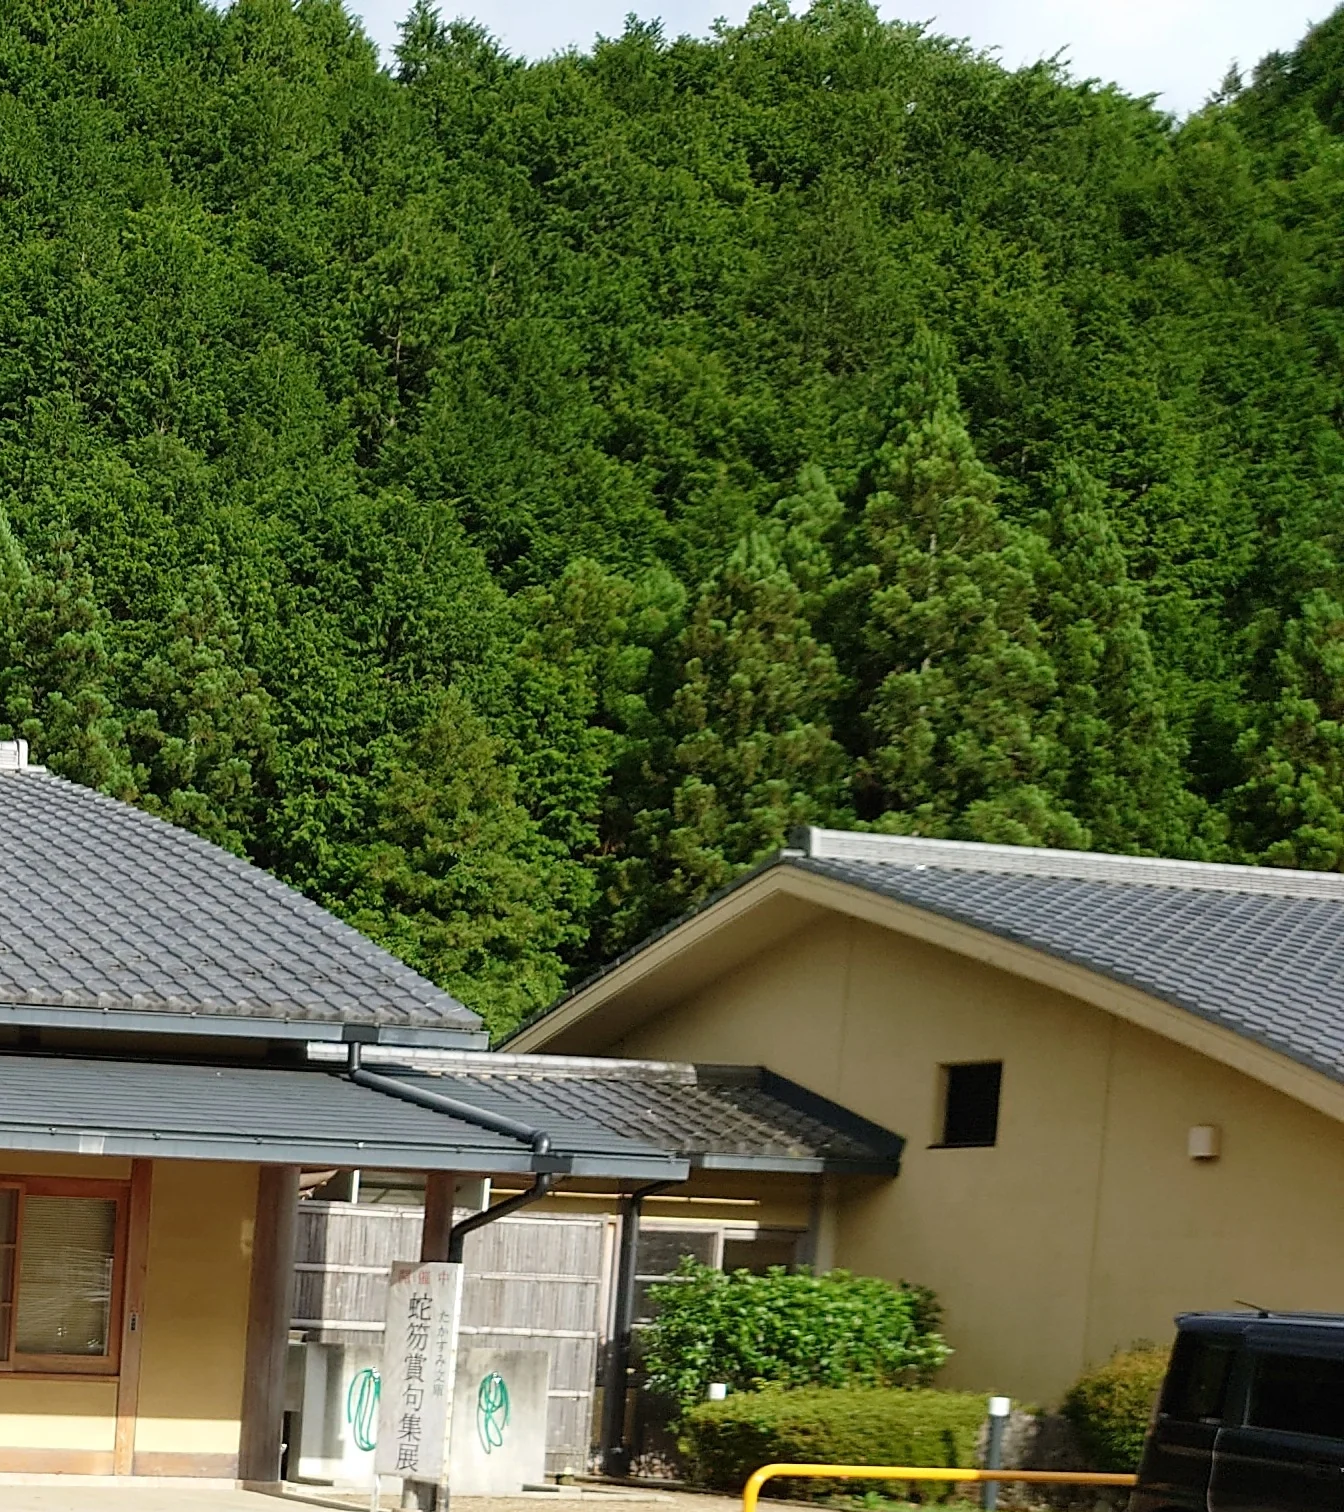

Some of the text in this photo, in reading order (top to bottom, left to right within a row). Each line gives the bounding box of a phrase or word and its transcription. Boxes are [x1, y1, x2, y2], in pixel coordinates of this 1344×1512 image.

[396, 1292, 433, 1473] 蛇笏賞句集展
[433, 1311, 450, 1397] たかすみ文庫
